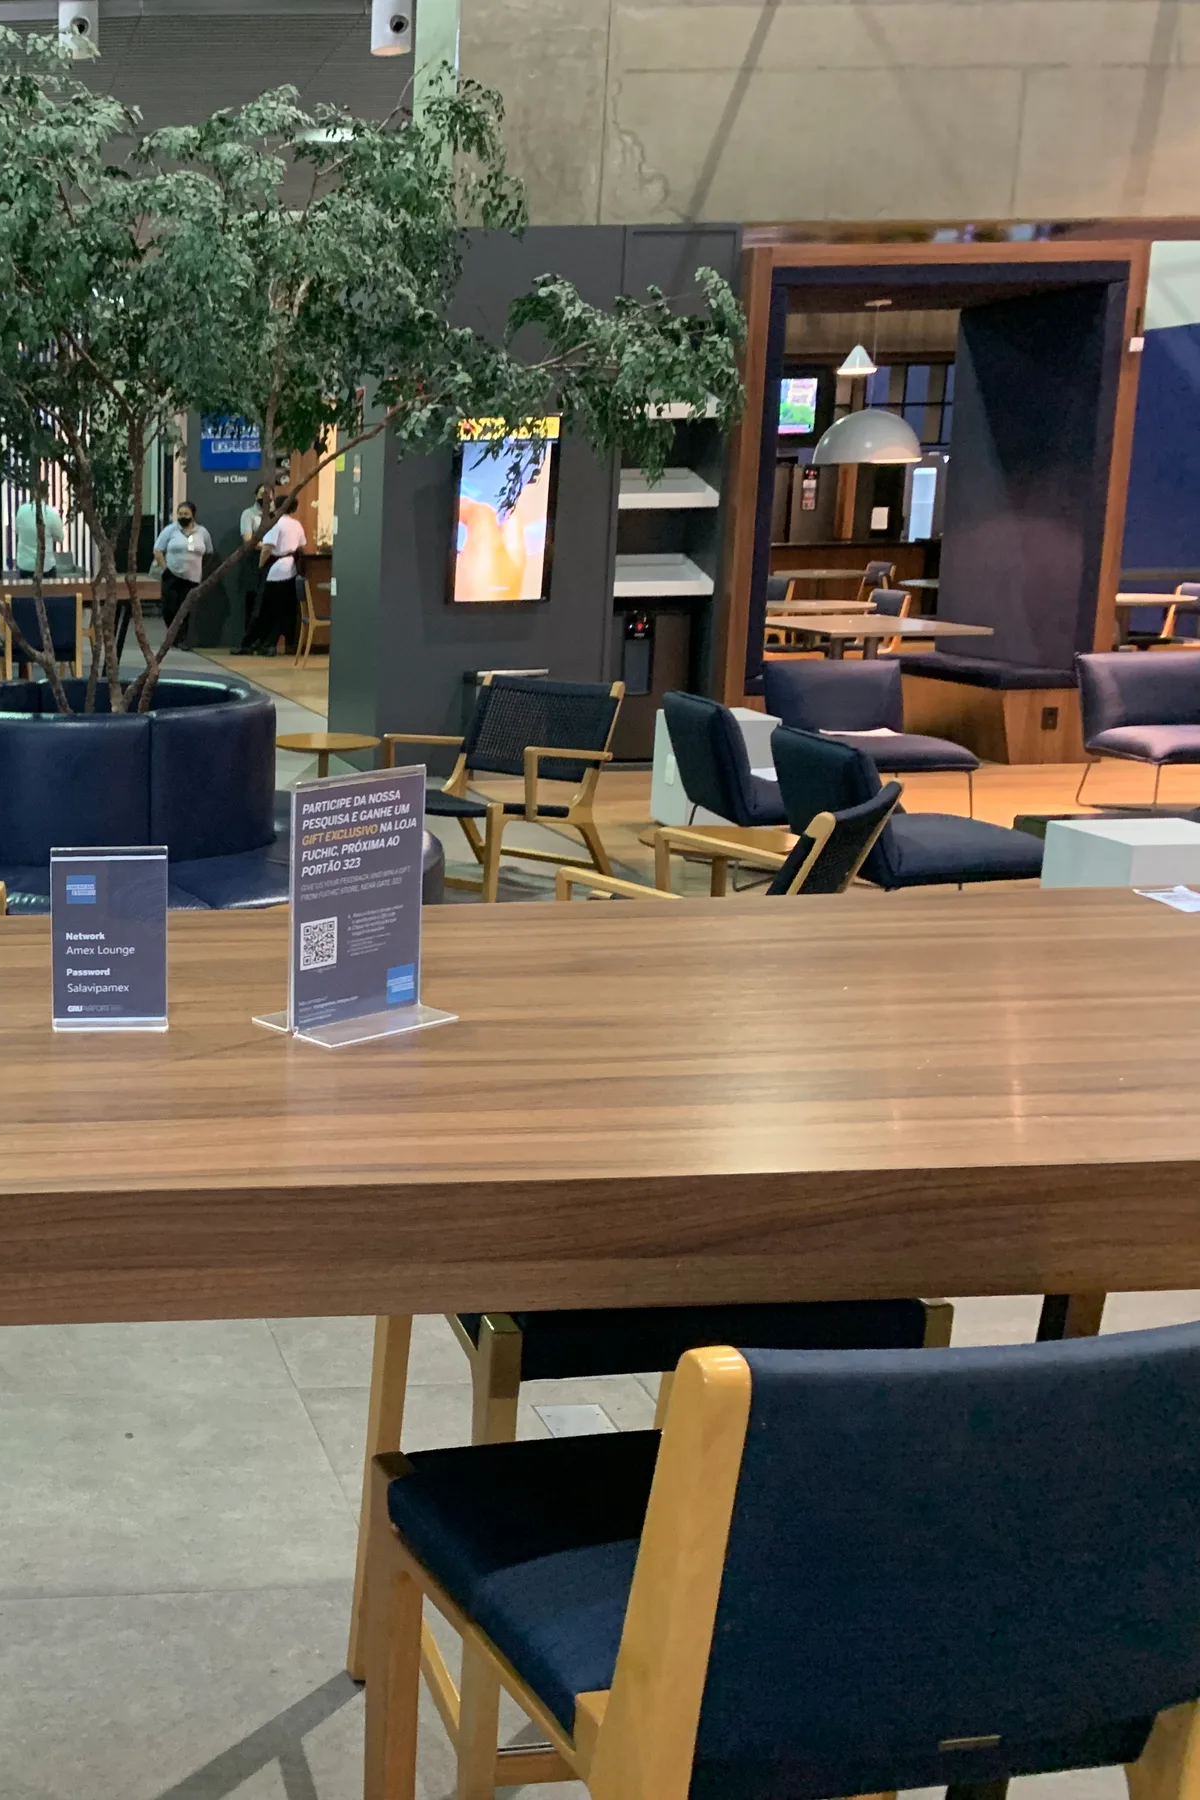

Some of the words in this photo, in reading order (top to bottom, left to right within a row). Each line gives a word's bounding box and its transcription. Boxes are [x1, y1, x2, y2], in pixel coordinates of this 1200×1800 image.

[214, 475, 229, 483] First
[230, 475, 248, 483] Class
[302, 797, 352, 815] PARTICIPE
[353, 795, 367, 806] DA
[368, 789, 401, 804] NOSSA
[302, 813, 350, 830] PESQUISA
[351, 811, 358, 823] E
[360, 806, 392, 821] GANHE
[394, 803, 411, 815] UM
[302, 832, 324, 846] GIFT
[325, 824, 378, 842] EXCLUSIVO
[379, 821, 392, 833] NA
[394, 817, 417, 831] LOJA
[341, 839, 385, 855] PRÓXIMA
[386, 835, 400, 847] AO
[301, 860, 341, 878] PORTÃO
[342, 857, 361, 870] 323
[66, 932, 105, 941] Network
[66, 946, 95, 955] Amex
[97, 945, 136, 957] Lounge
[66, 968, 111, 976] Password
[67, 983, 130, 995] Salavipamex
